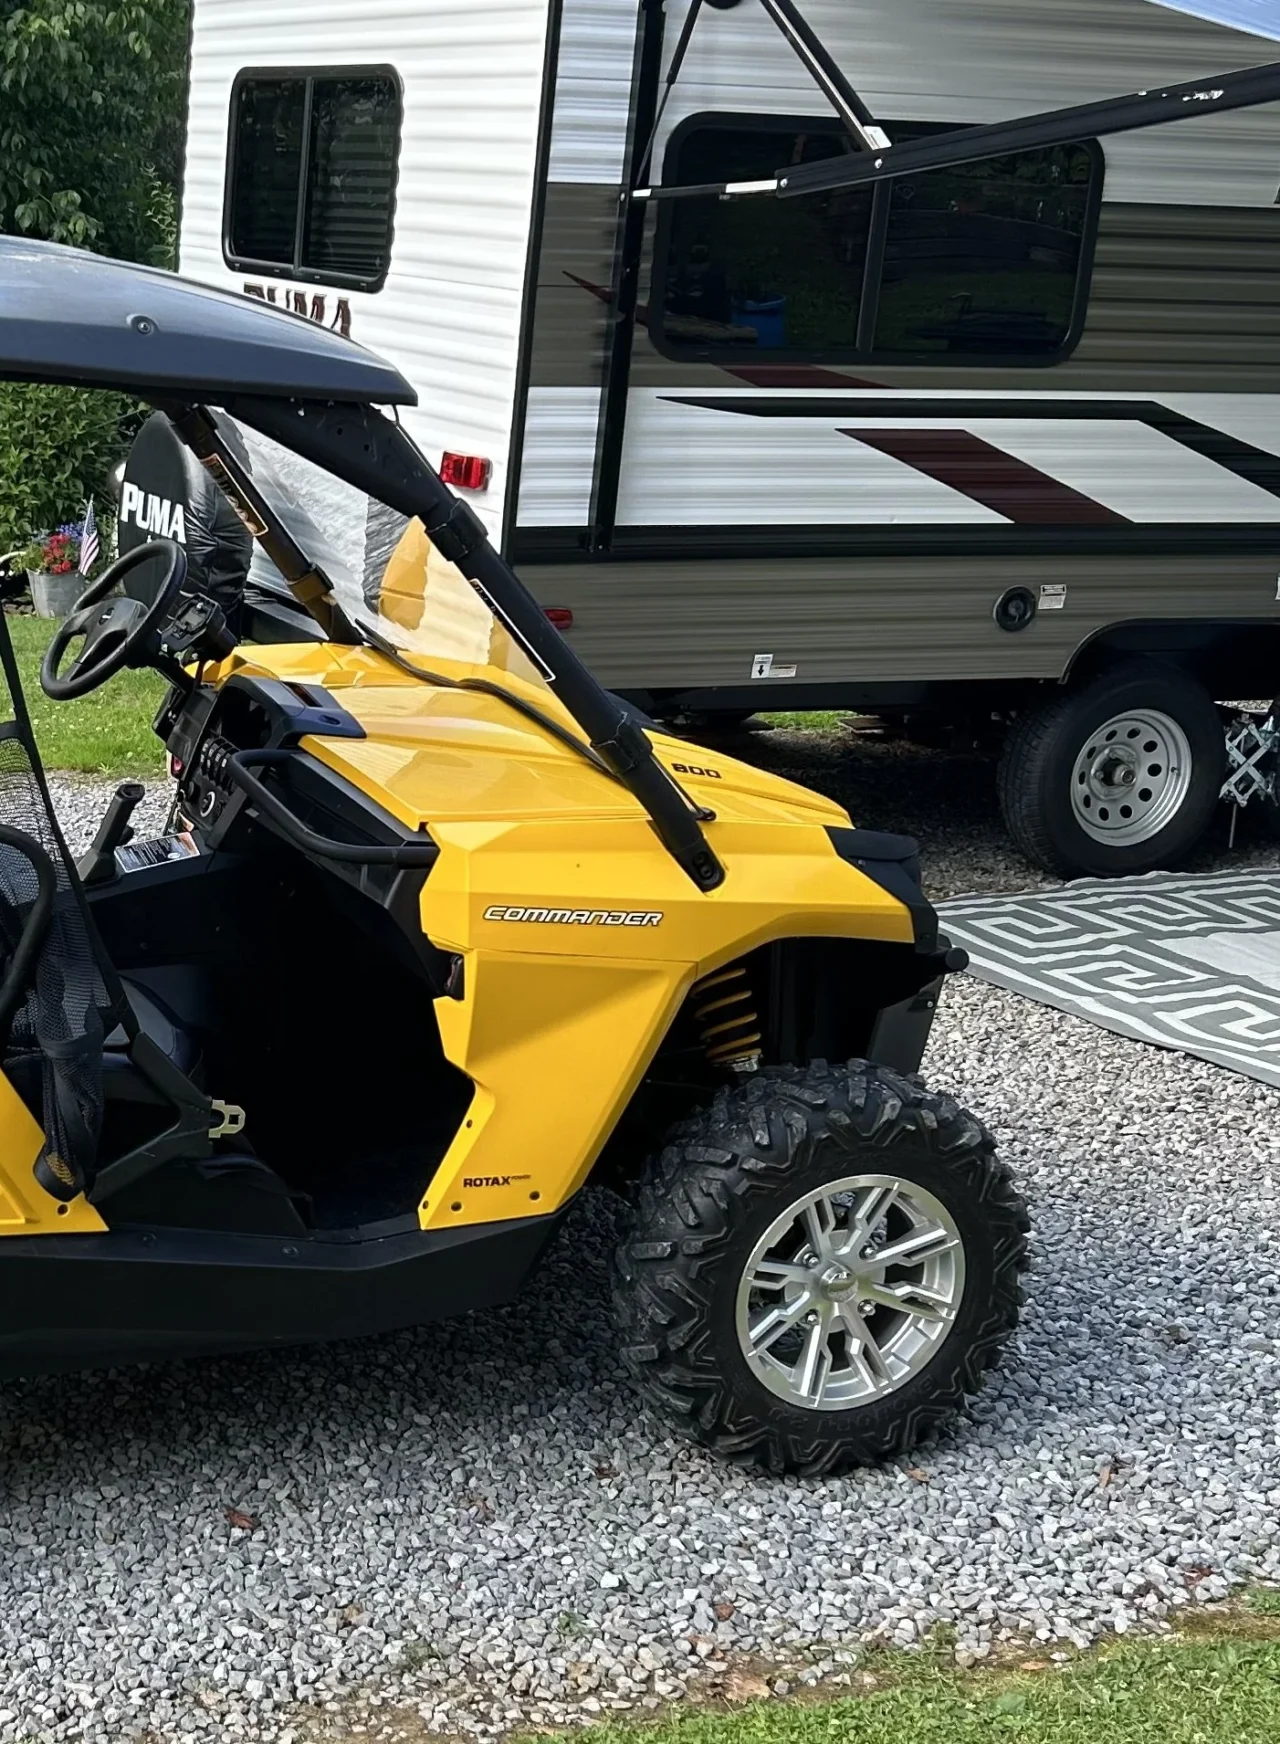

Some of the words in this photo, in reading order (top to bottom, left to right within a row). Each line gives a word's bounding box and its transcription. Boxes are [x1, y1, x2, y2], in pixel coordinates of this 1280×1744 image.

[121, 481, 186, 544] PUMA
[671, 763, 722, 779] 800
[483, 905, 665, 926] COMMANDER
[463, 1175, 511, 1188] ROTAX
